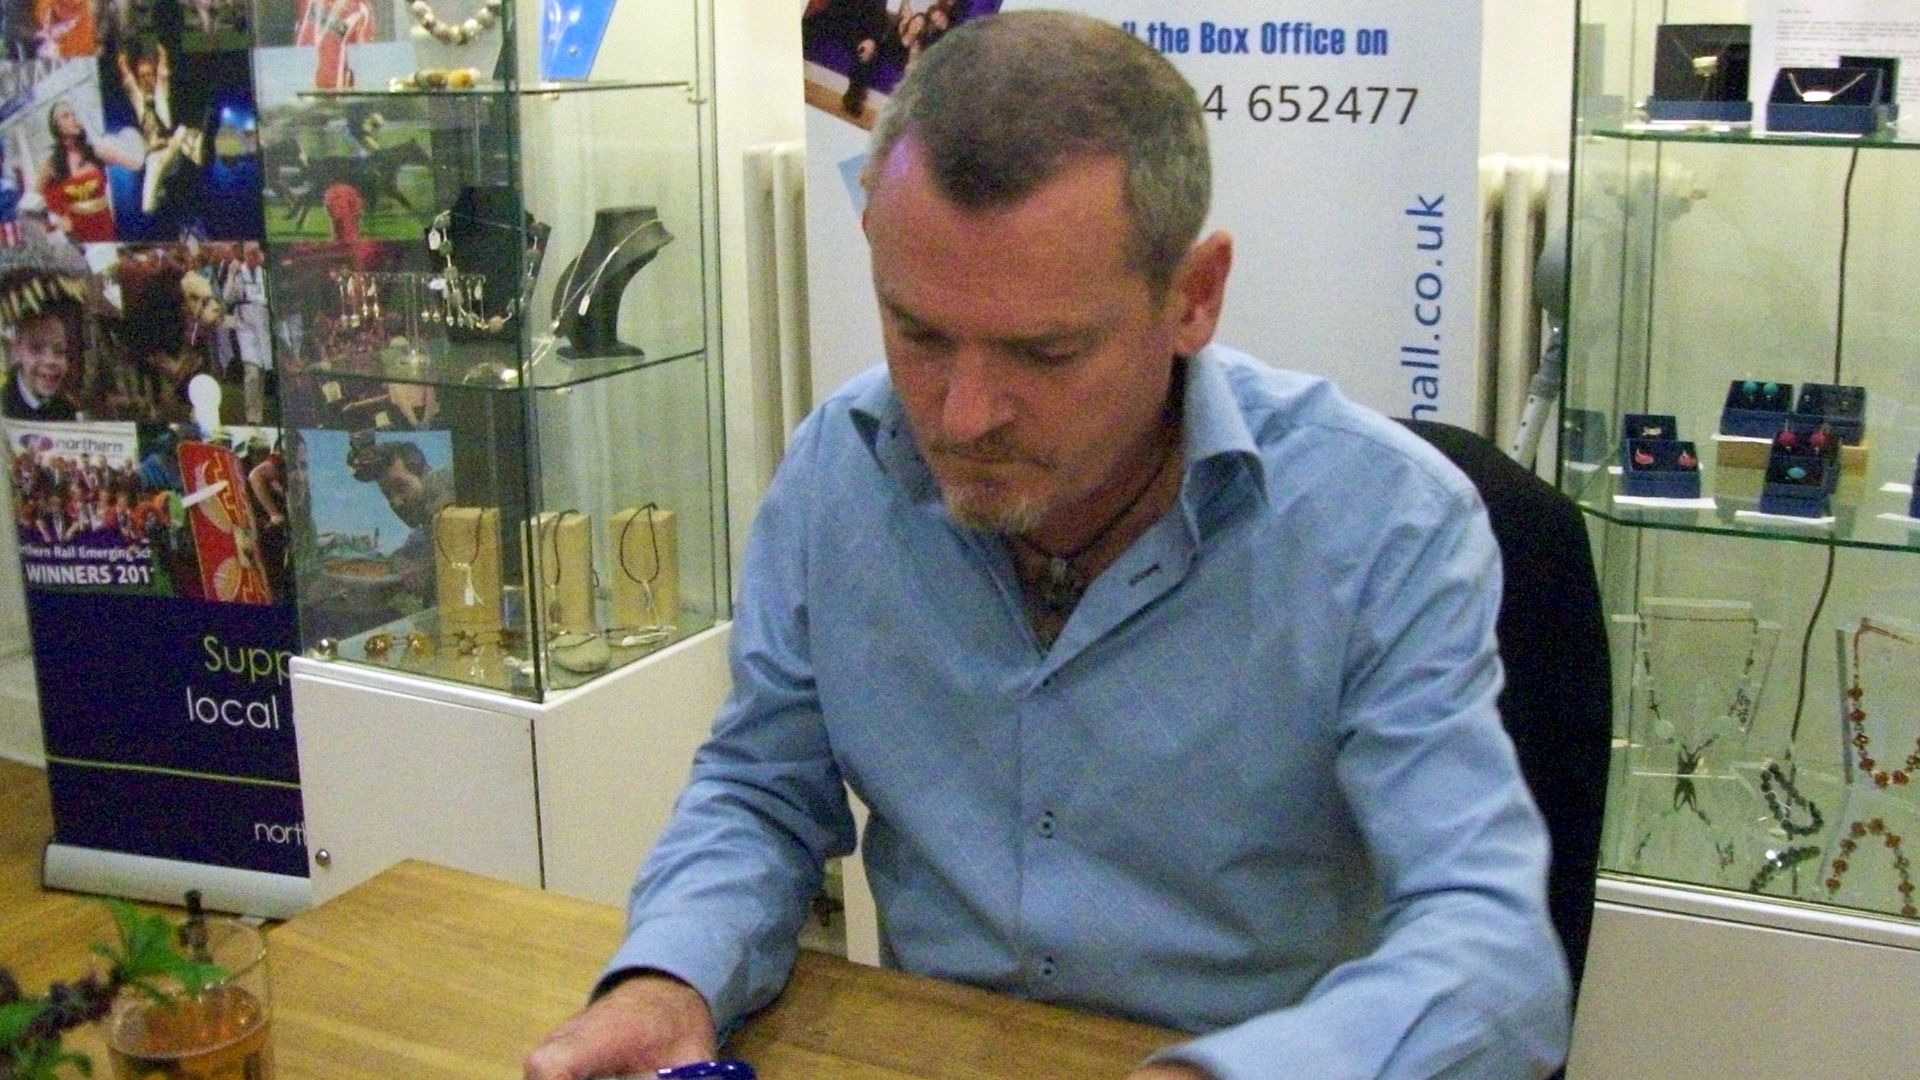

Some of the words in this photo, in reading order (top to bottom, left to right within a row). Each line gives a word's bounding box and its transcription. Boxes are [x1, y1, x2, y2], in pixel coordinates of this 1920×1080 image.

[1147, 22, 1189, 53] the
[1200, 22, 1249, 54] Box
[1261, 22, 1345, 55] Office
[1357, 28, 1388, 55] on
[1204, 85, 1227, 120] 4
[1249, 85, 1419, 124] 652477
[54, 546, 75, 558] Rail
[25, 563, 112, 584] WINNERS
[115, 565, 150, 584] 201
[203, 635, 293, 686] Supp
[186, 686, 279, 730] local
